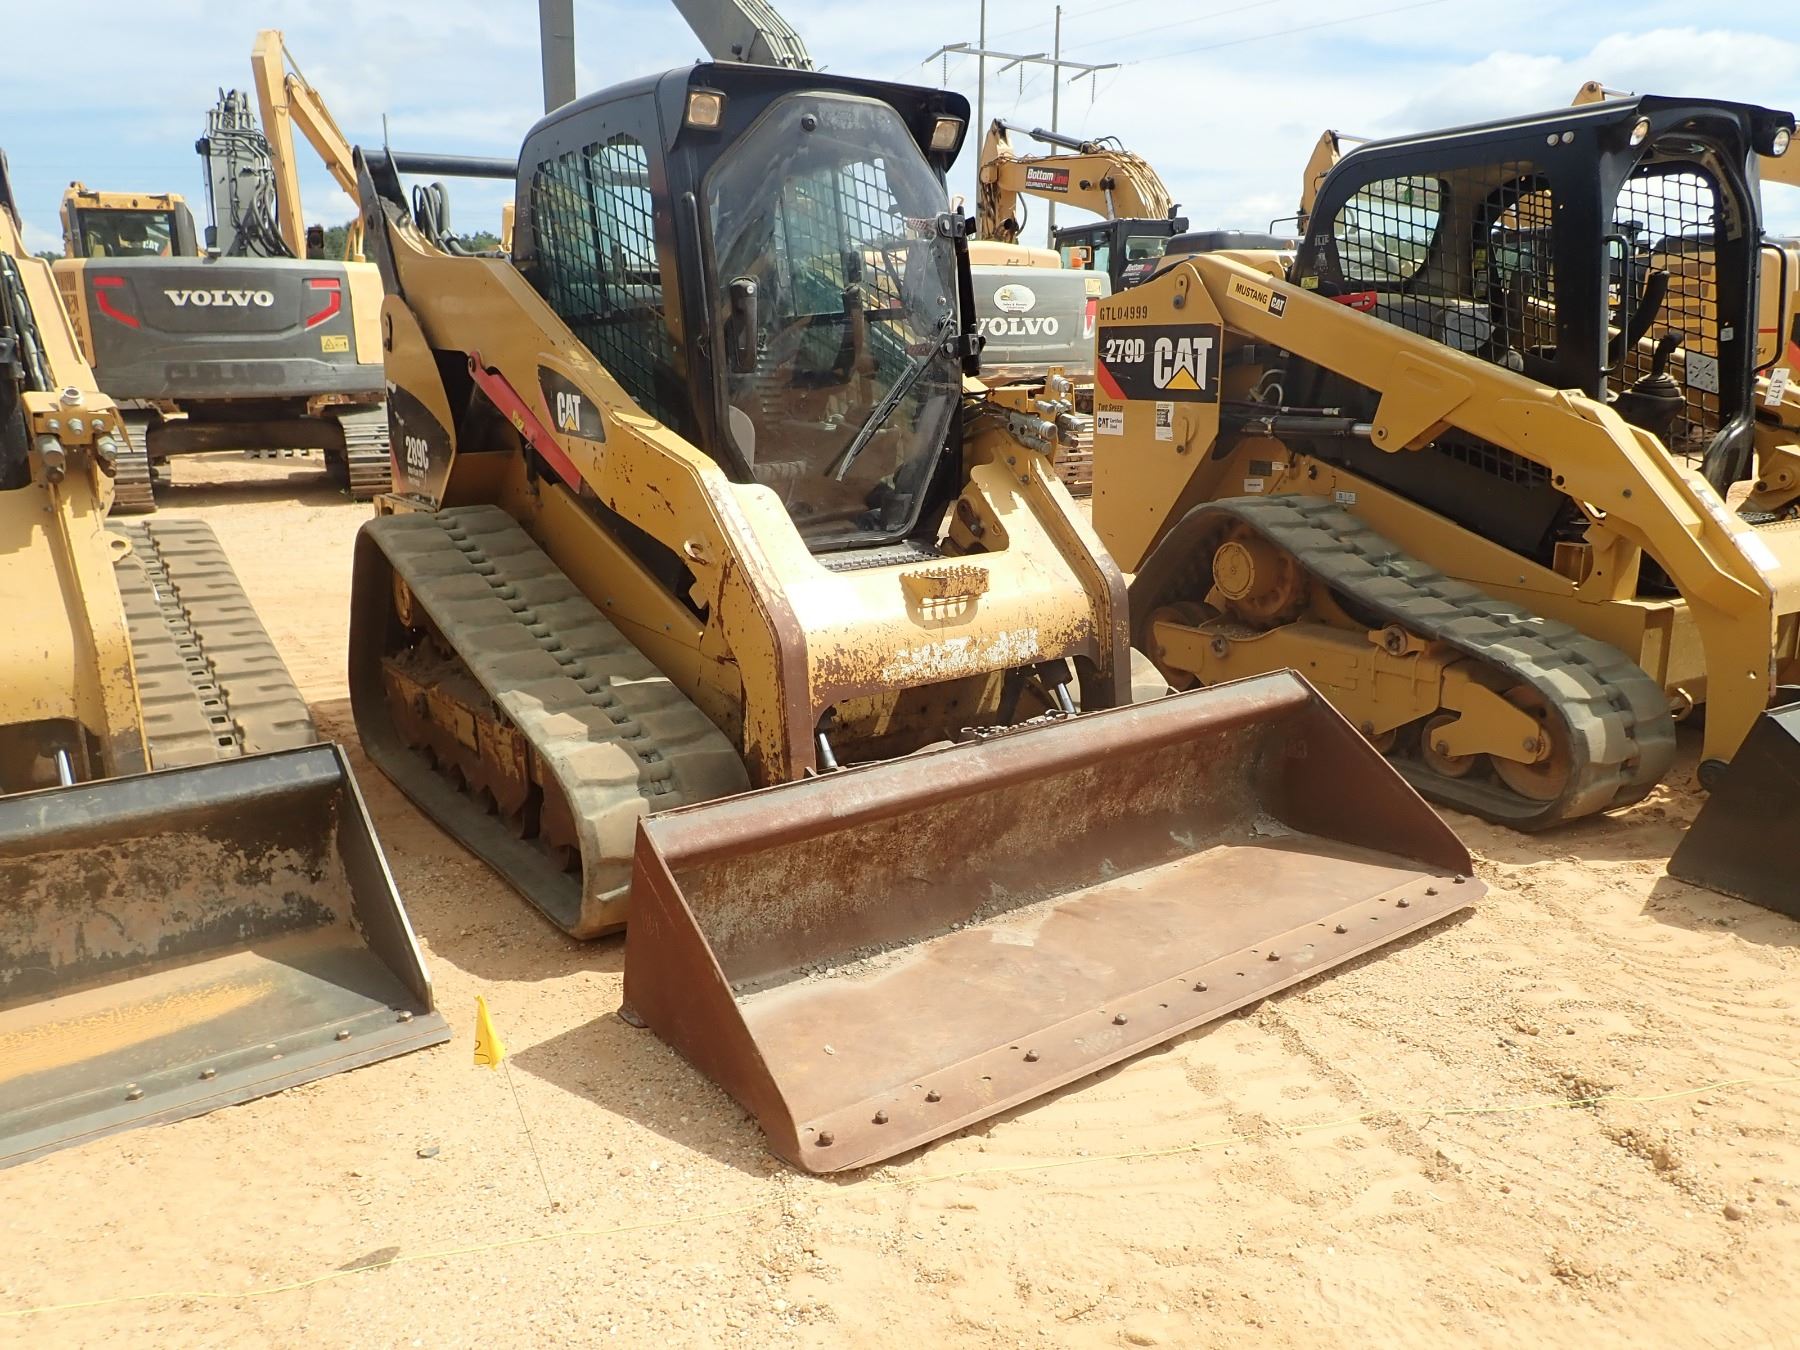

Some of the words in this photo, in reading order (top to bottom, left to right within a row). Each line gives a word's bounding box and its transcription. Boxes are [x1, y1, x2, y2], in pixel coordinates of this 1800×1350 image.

[1027, 168, 1054, 181] Bottom
[164, 289, 275, 307] VOLVO
[1234, 283, 1269, 304] MUSTANG
[1270, 296, 1286, 312] CAT
[1105, 338, 1146, 364] 279D
[1152, 336, 1213, 391] CAT
[556, 391, 581, 432] CAT
[1098, 417, 1109, 428] CAT
[405, 435, 430, 470] 289C
